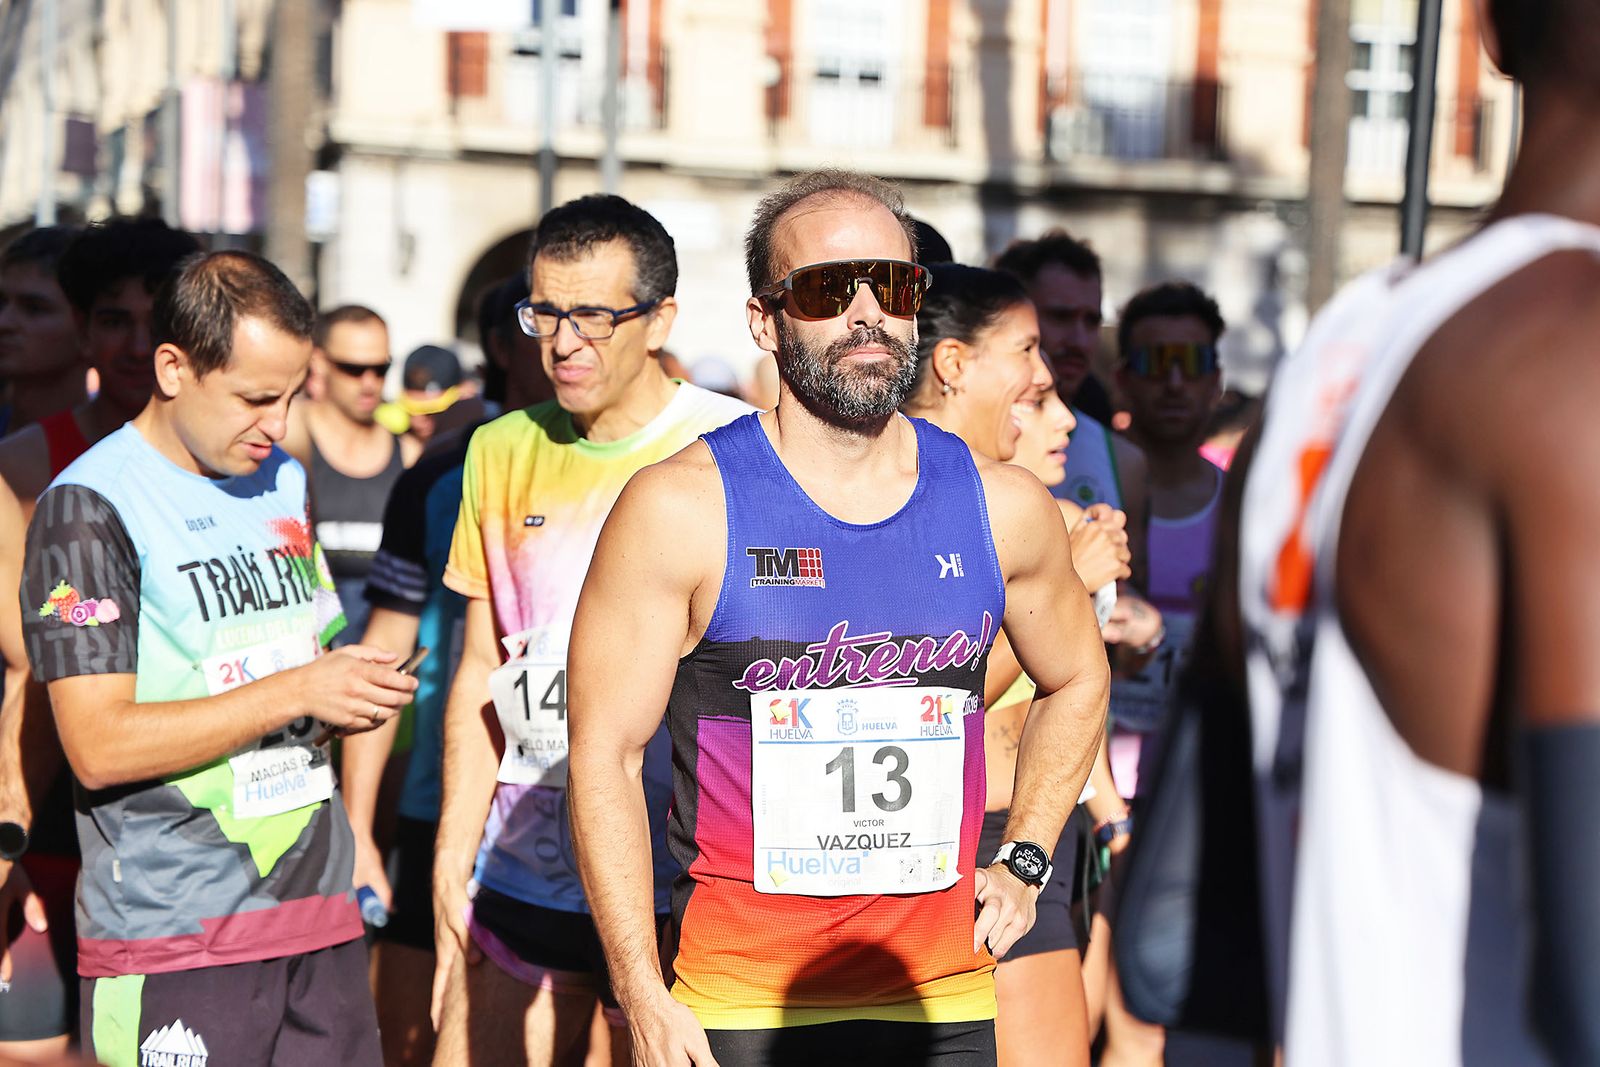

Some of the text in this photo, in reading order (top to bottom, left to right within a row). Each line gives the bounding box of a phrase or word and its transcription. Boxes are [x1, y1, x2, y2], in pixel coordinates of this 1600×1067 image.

[746, 548, 800, 577] TM
[732, 611, 992, 692] entrena!
[769, 729, 814, 740] HUELVA
[861, 721, 898, 731] HUELVA
[920, 725, 953, 737] HUELVA
[251, 757, 298, 782] MACIAS
[825, 745, 912, 813] 13
[245, 773, 307, 802] Huelva
[853, 818, 885, 828] VICTOR
[817, 832, 912, 851] VAZQUEZ
[767, 850, 861, 875] Huelva
